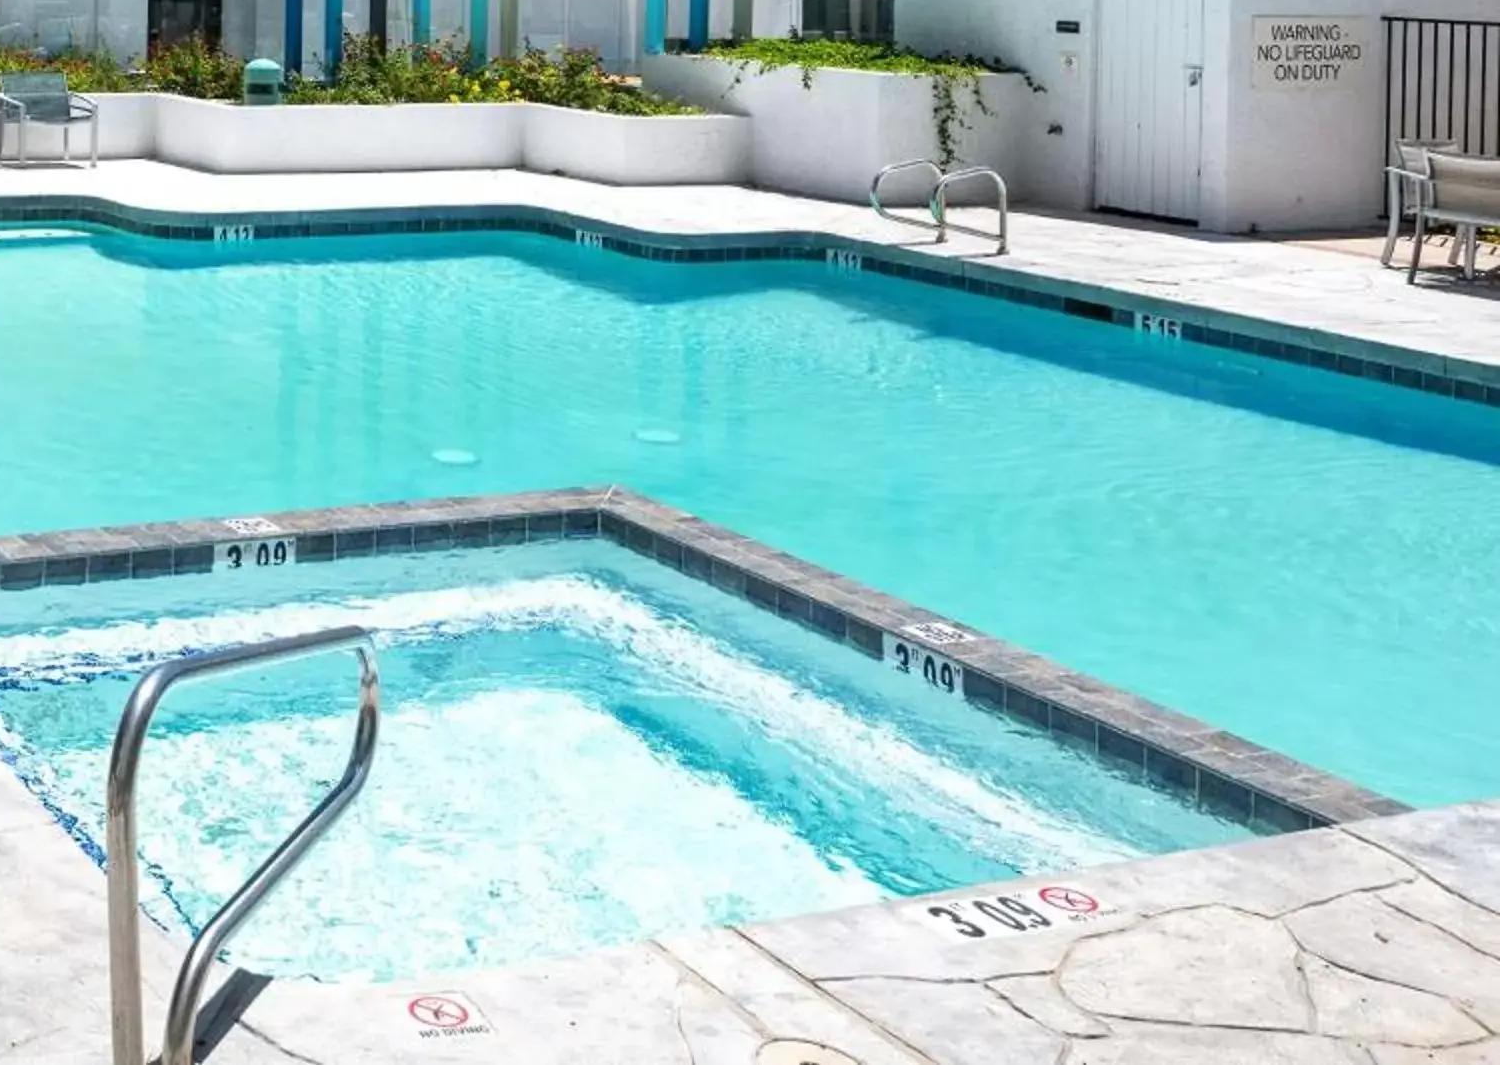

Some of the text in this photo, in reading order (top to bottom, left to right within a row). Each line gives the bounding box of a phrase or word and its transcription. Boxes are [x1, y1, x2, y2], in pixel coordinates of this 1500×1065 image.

[1271, 24, 1341, 41] WARNING
[1257, 44, 1362, 61] NO LIFEGUARD
[1274, 64, 1342, 81] ON DUTY
[227, 544, 243, 569] 3
[895, 642, 911, 675] 3
[927, 905, 987, 938] 3
